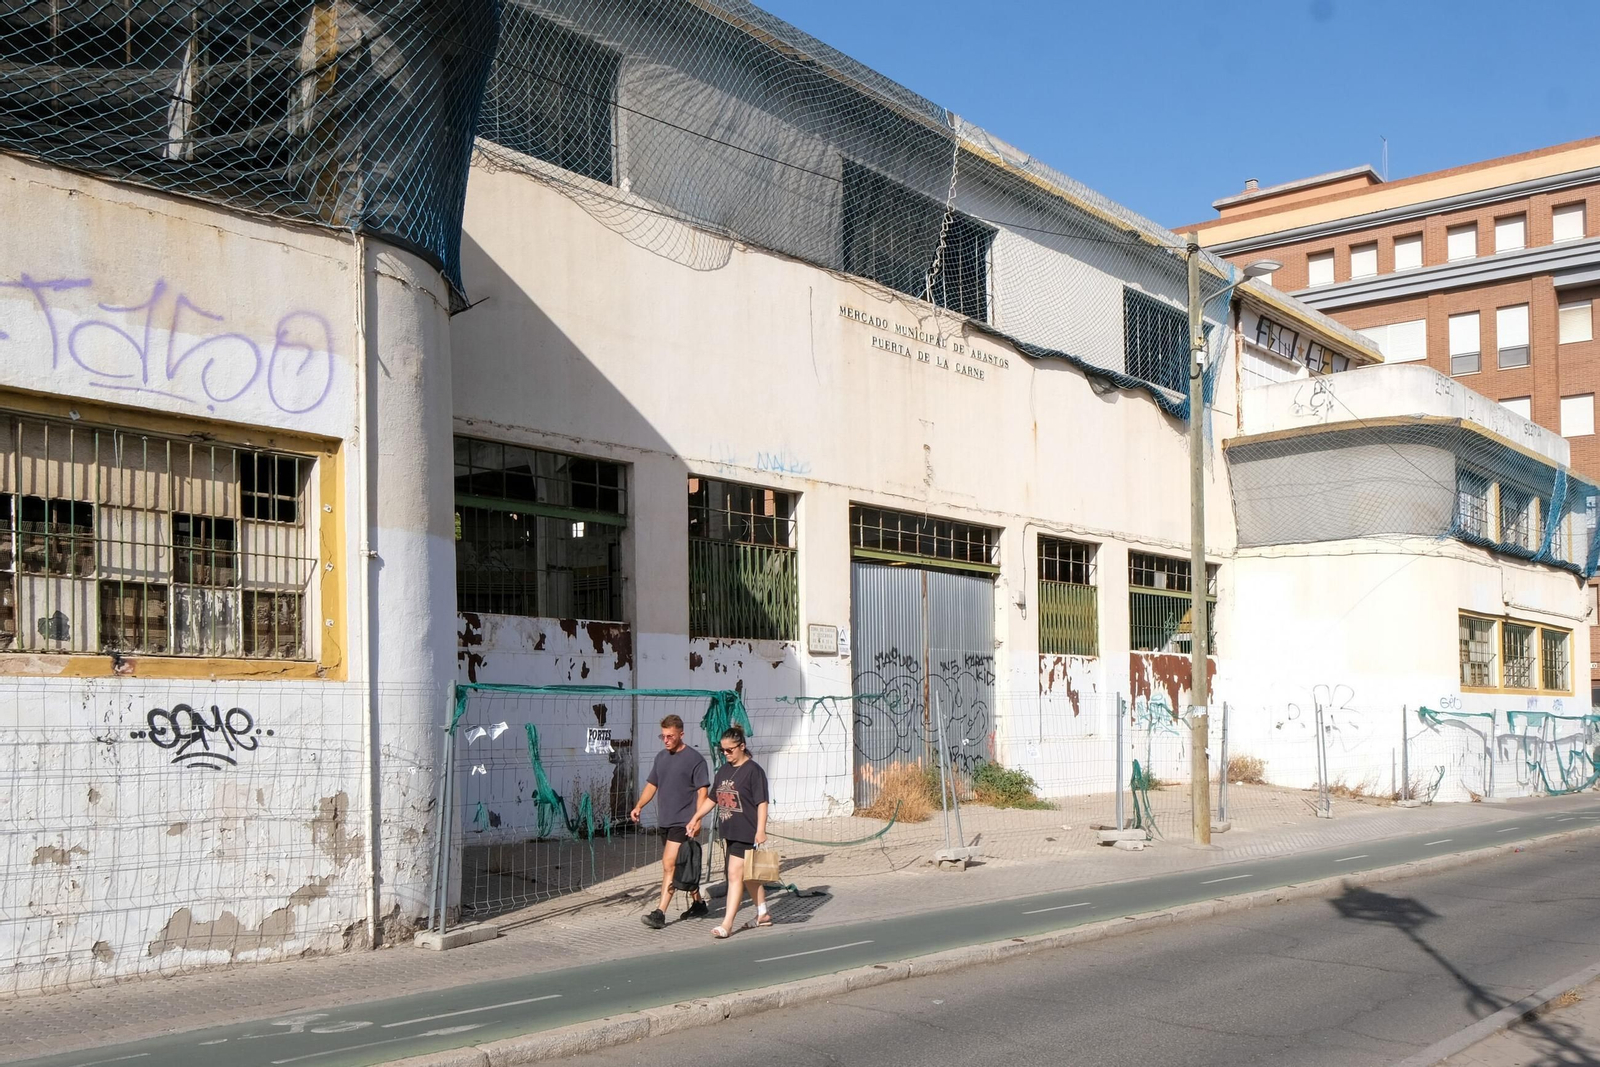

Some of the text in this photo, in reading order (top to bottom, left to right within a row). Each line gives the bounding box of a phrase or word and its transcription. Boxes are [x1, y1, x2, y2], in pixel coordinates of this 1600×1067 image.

[839, 305, 1010, 370] MERCADO MUNICIPAL DE ABASTOS
[871, 335, 985, 381] PUERTA DE LA CARNE
